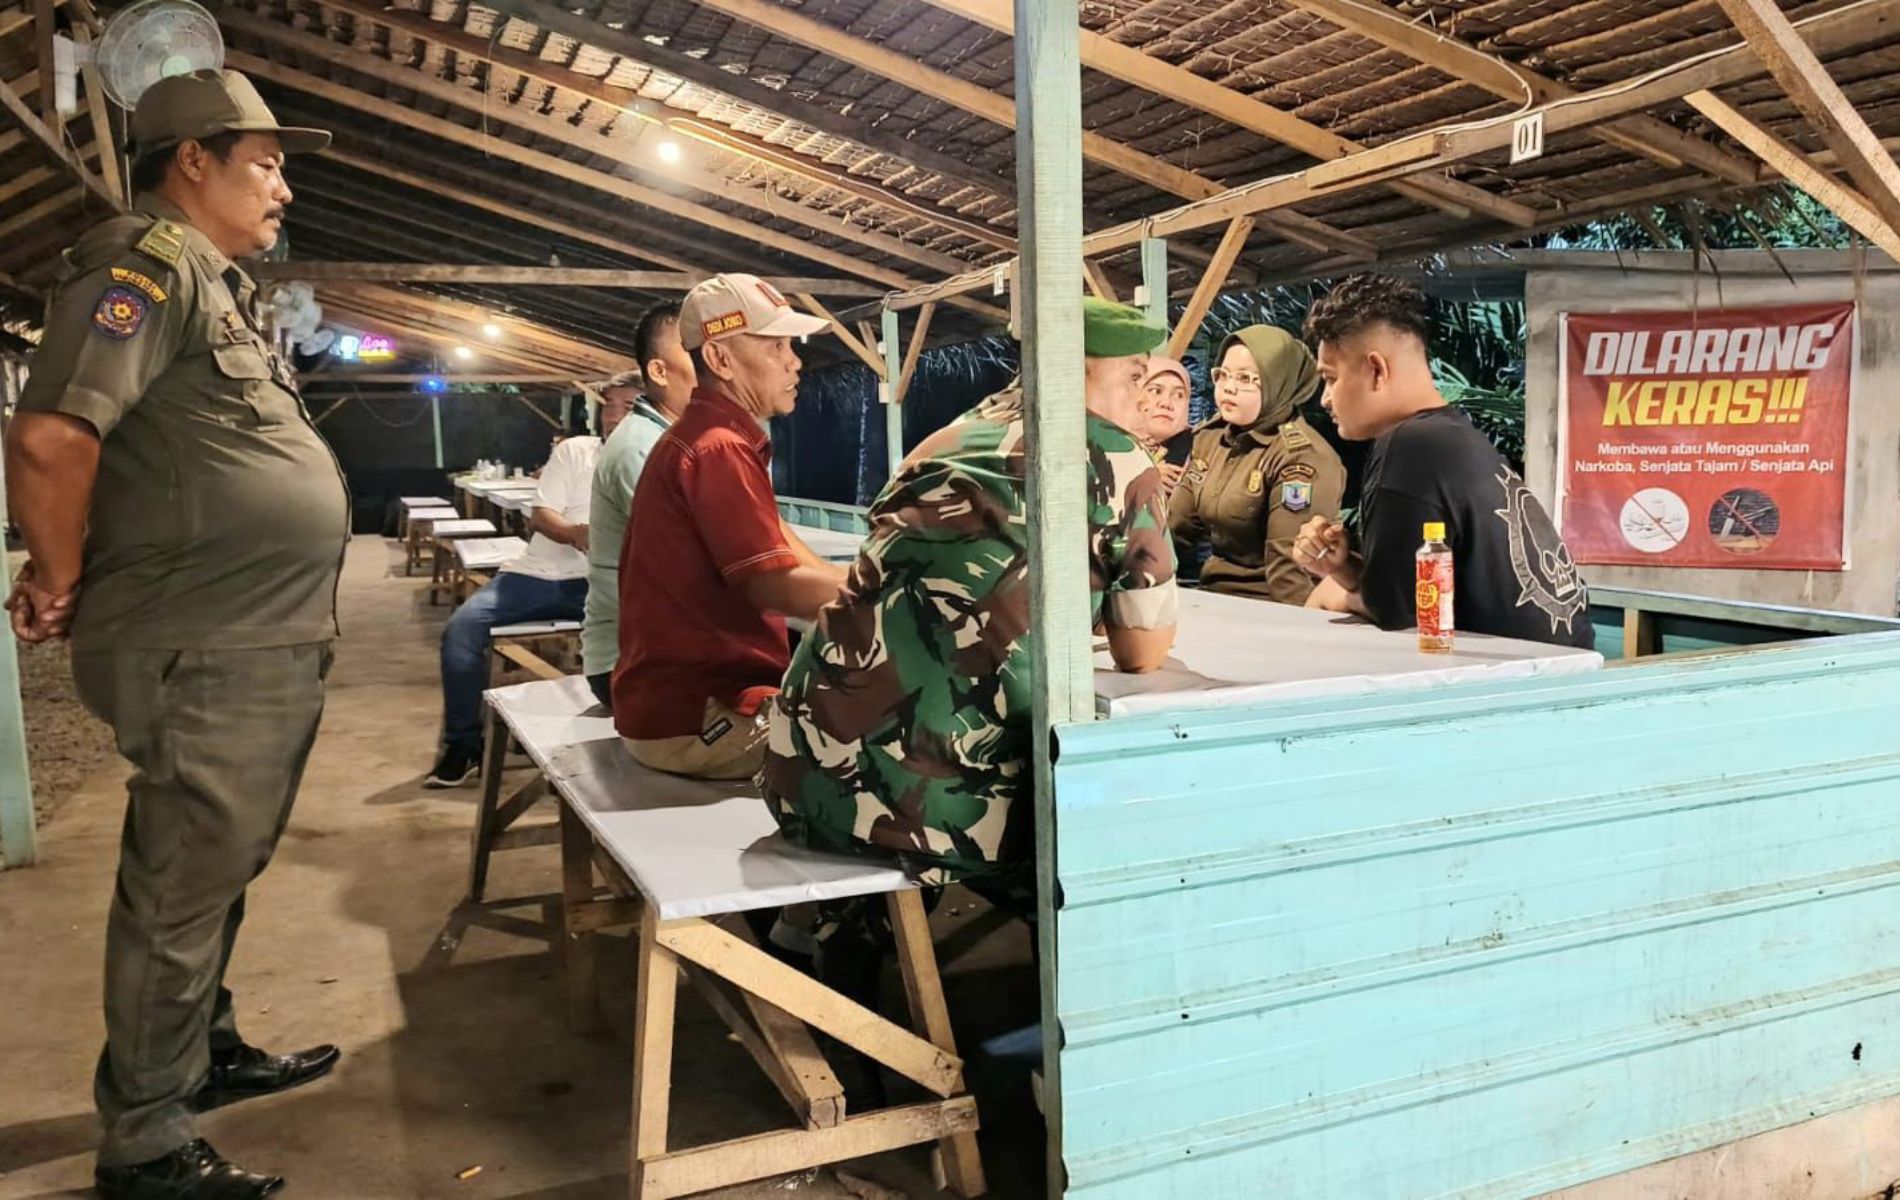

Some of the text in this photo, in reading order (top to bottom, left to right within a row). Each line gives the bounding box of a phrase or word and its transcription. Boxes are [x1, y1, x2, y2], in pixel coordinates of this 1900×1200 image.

[1518, 121, 1537, 154] 01
[1583, 324, 1835, 375] DILARANG
[1602, 377, 1809, 426] KERAS!!!
[1598, 441, 1809, 457] Membawa atau Menggunakan
[1575, 460, 1636, 473] Narkoba,
[1640, 460, 1692, 475] Senjata
[1696, 460, 1738, 475] Tajam
[1750, 459, 1805, 475] Senjata
[1808, 459, 1834, 474] Api
